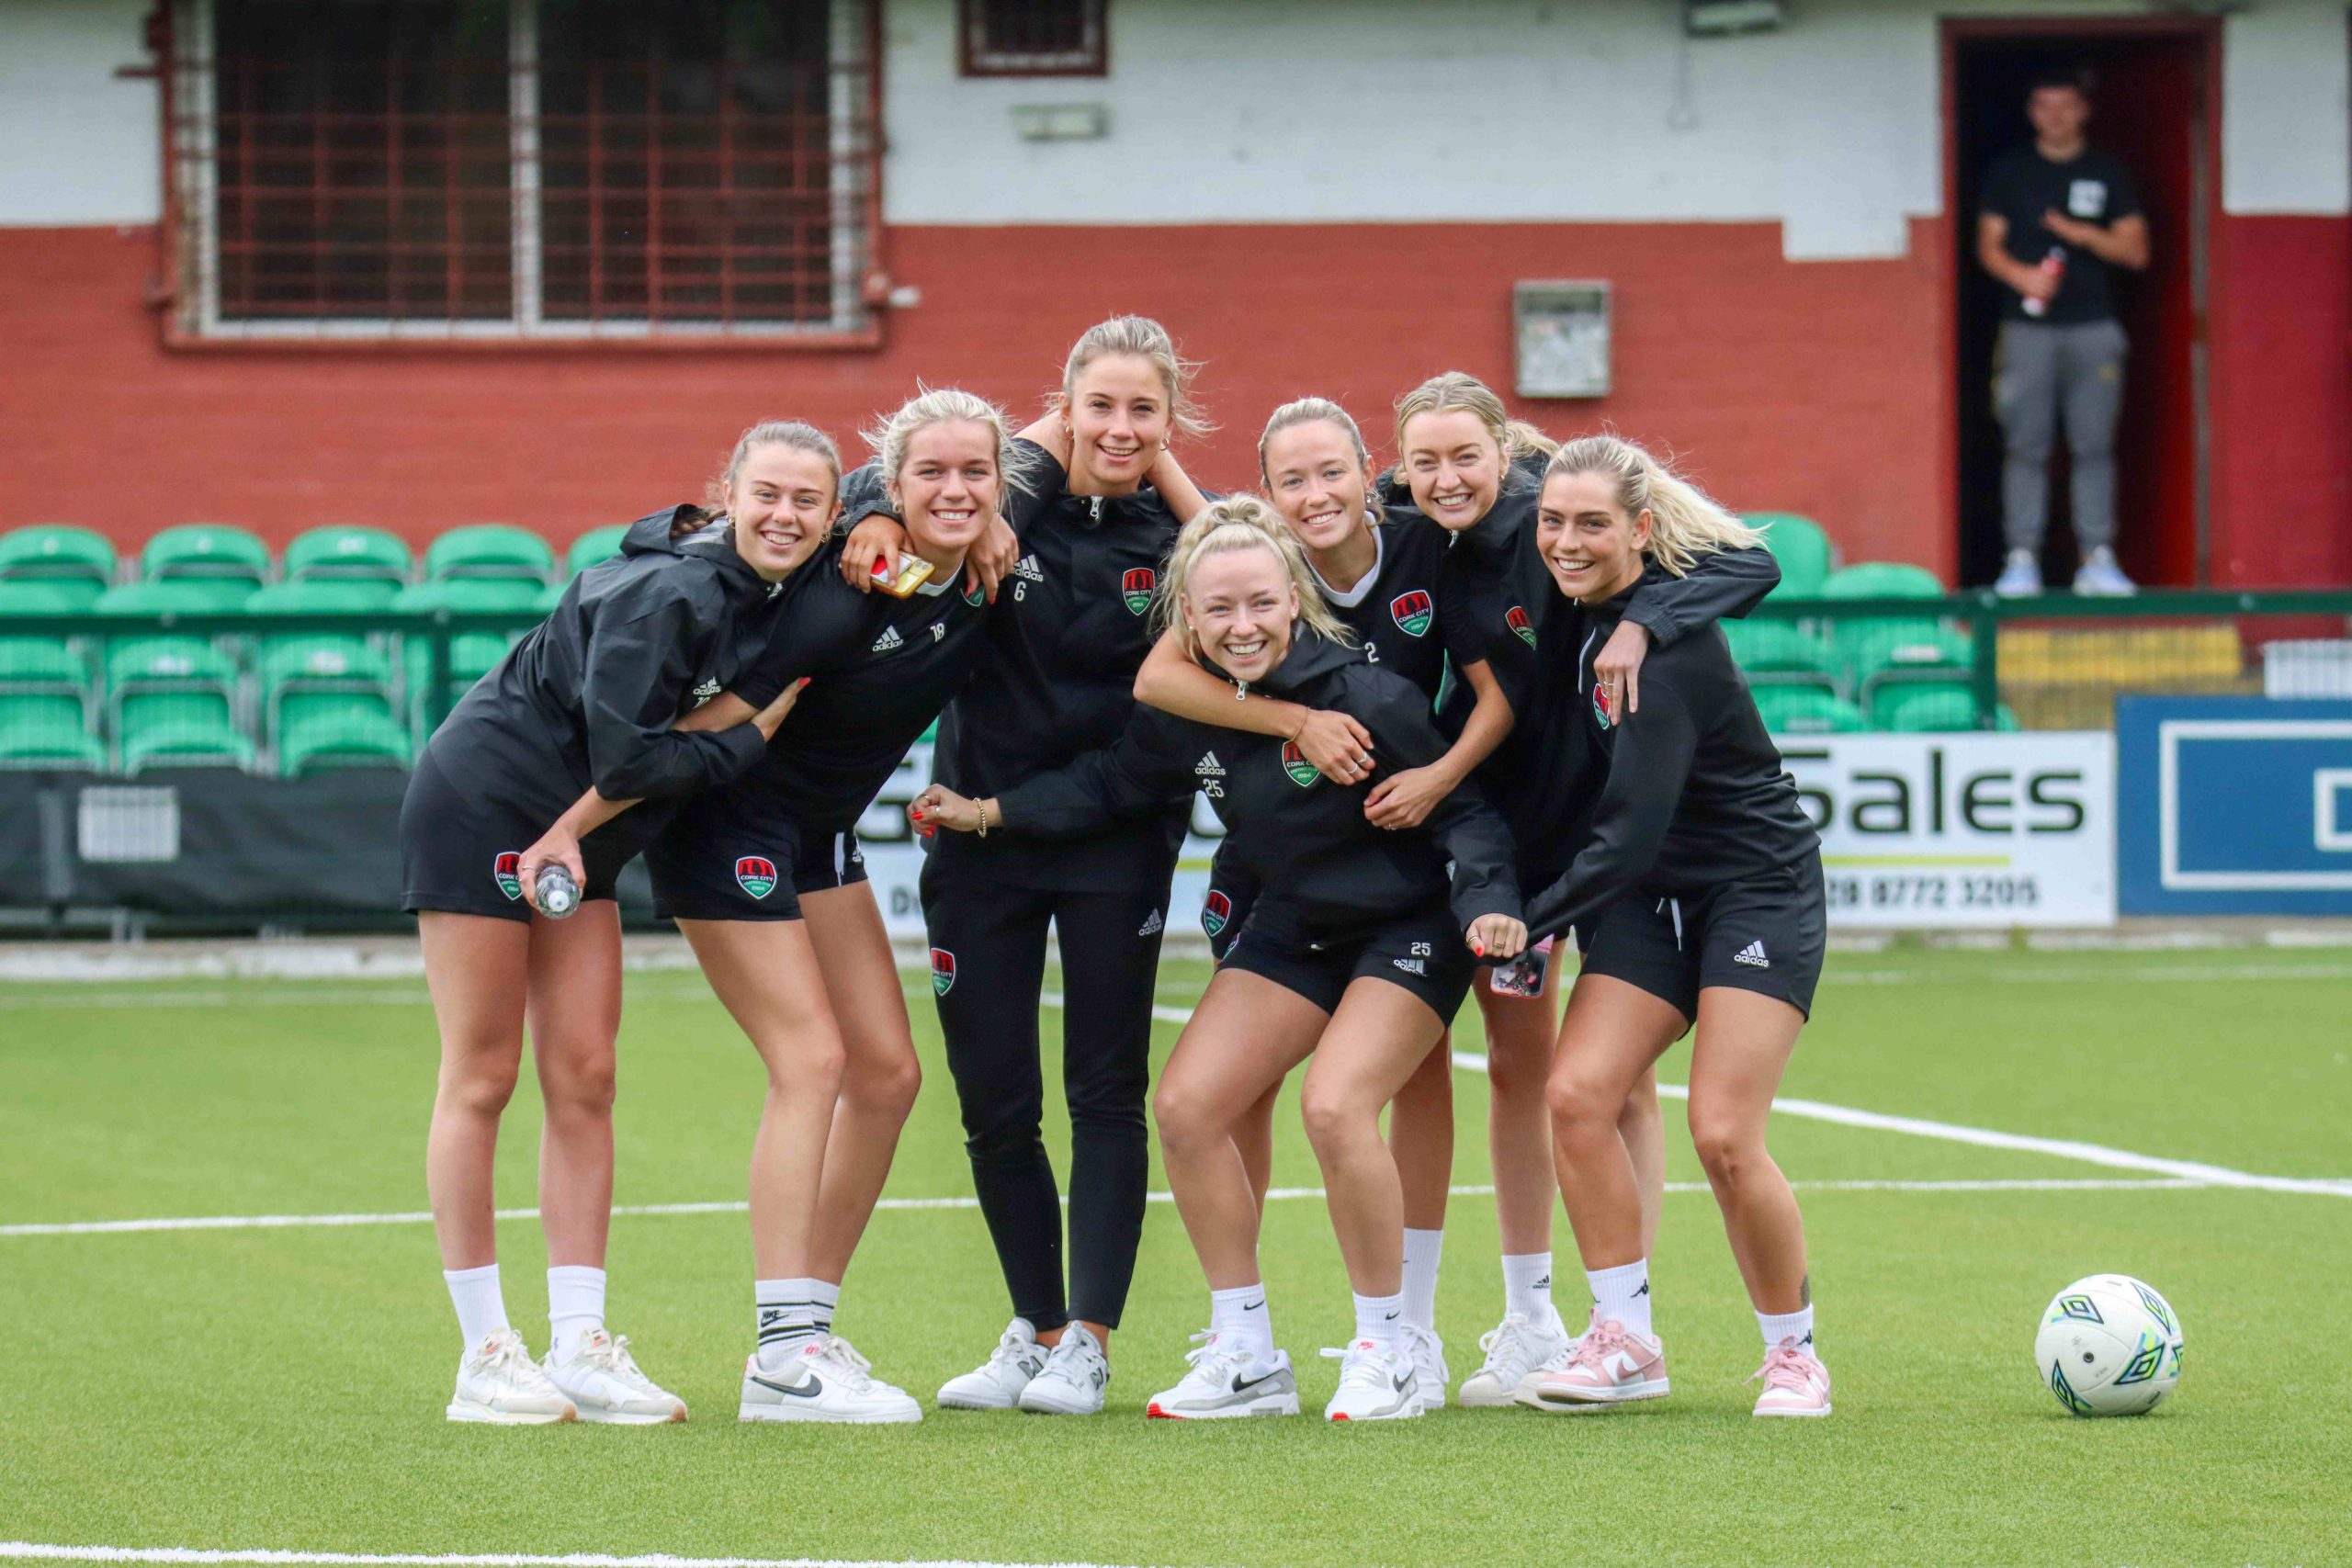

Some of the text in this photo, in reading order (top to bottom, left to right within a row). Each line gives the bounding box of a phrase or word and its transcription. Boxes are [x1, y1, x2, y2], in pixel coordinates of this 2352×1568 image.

[1014, 581, 1027, 602] 6
[1398, 614, 1416, 623] CORK
[1416, 607, 1430, 616] CITY
[930, 623, 944, 642] 18
[872, 638, 904, 651] adidas
[1364, 641, 1379, 663] 2
[1195, 766, 1226, 775] adidas
[1203, 778, 1224, 797] 25
[1781, 748, 2085, 834] Sales
[1411, 942, 1430, 956] 25
[1734, 954, 1770, 968] adidas
[763, 1310, 780, 1319] NIKE
